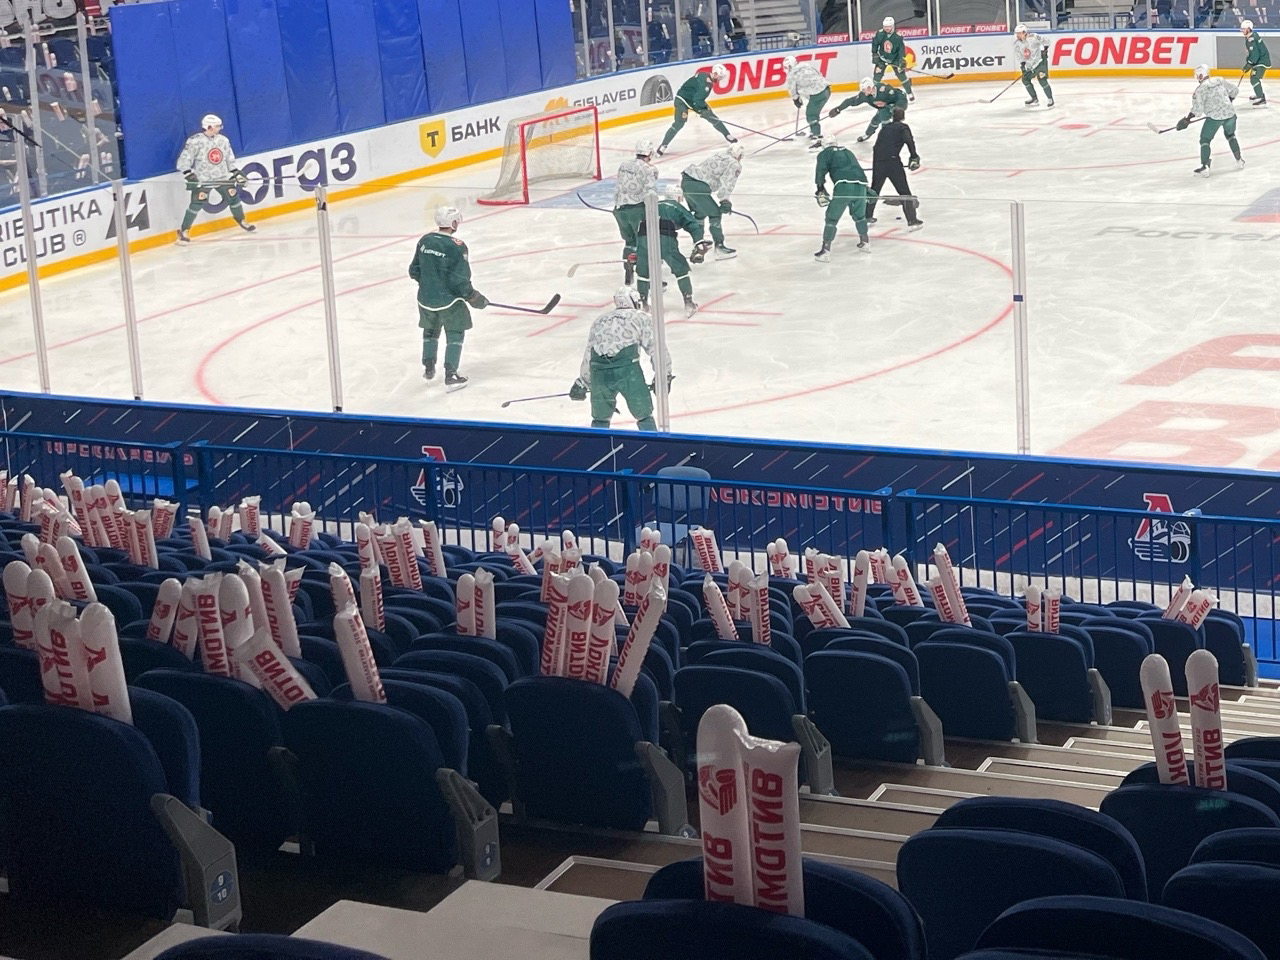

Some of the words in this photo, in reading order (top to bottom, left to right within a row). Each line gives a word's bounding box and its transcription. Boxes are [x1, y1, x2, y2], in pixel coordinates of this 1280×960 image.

[921, 44, 962, 56] Яндекс
[1051, 36, 1199, 66] FONBET
[921, 55, 1006, 71] Маркет
[451, 116, 502, 143] БАНК
